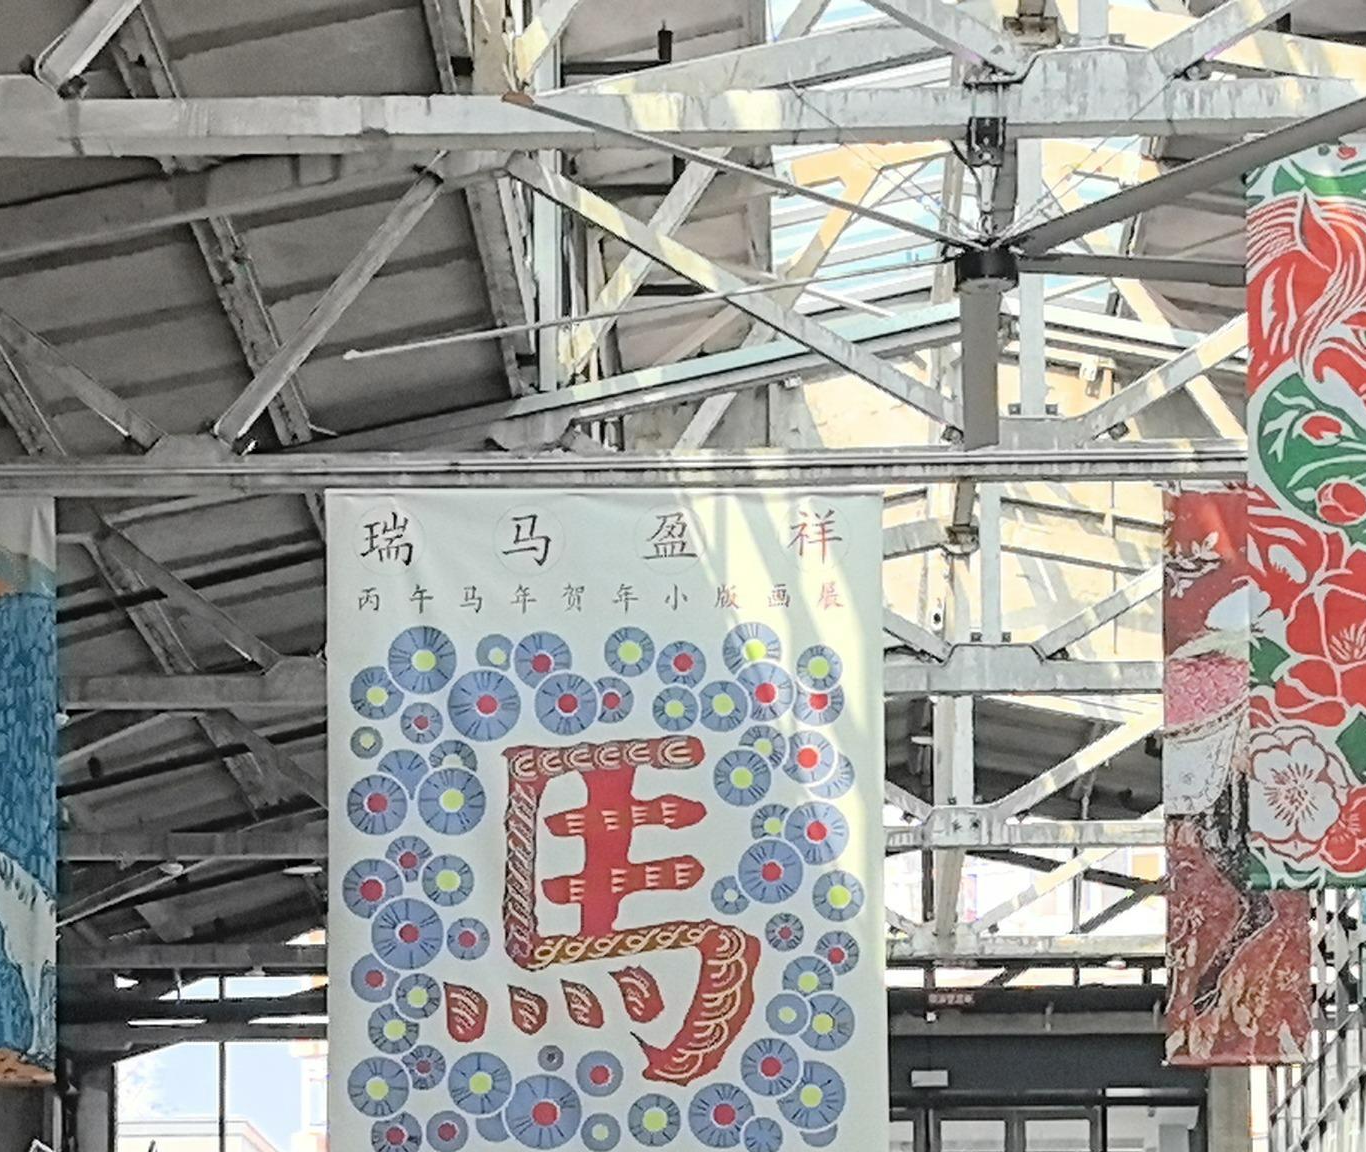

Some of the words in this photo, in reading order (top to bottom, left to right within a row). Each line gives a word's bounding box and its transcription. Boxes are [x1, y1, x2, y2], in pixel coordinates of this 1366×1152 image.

[360, 510, 843, 567] 瑞马盈祥
[357, 583, 844, 612] 丙午马年贺年小版画展
